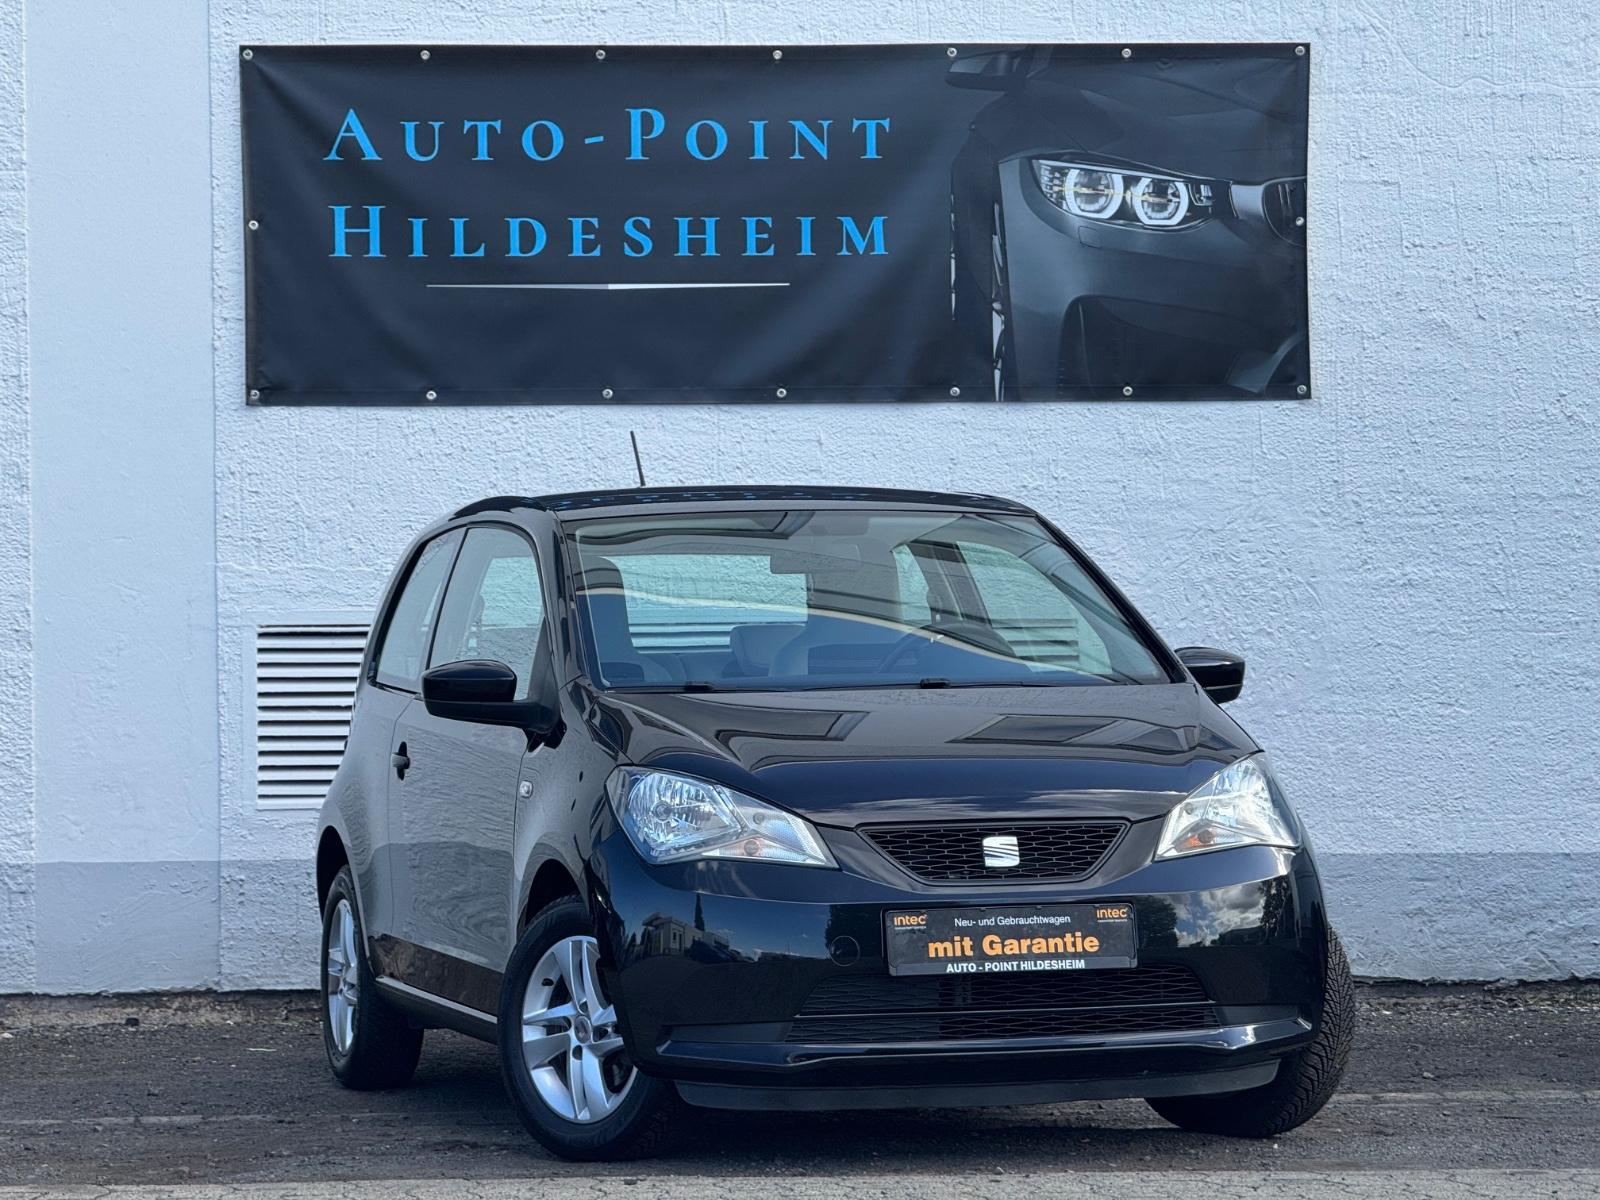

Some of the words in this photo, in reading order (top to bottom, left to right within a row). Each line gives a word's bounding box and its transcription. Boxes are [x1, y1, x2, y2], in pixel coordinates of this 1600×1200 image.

[1097, 908, 1127, 918] intec
[893, 914, 927, 926] intec
[954, 918, 976, 928] Neu-
[979, 917, 995, 927] und
[997, 914, 1071, 926] Gebrauchtwagen
[928, 936, 974, 958] mit
[982, 931, 1100, 956] Garantie
[946, 963, 977, 973] AUTO
[984, 961, 1018, 972] POINT
[1020, 960, 1086, 971] HILDESHEIM
